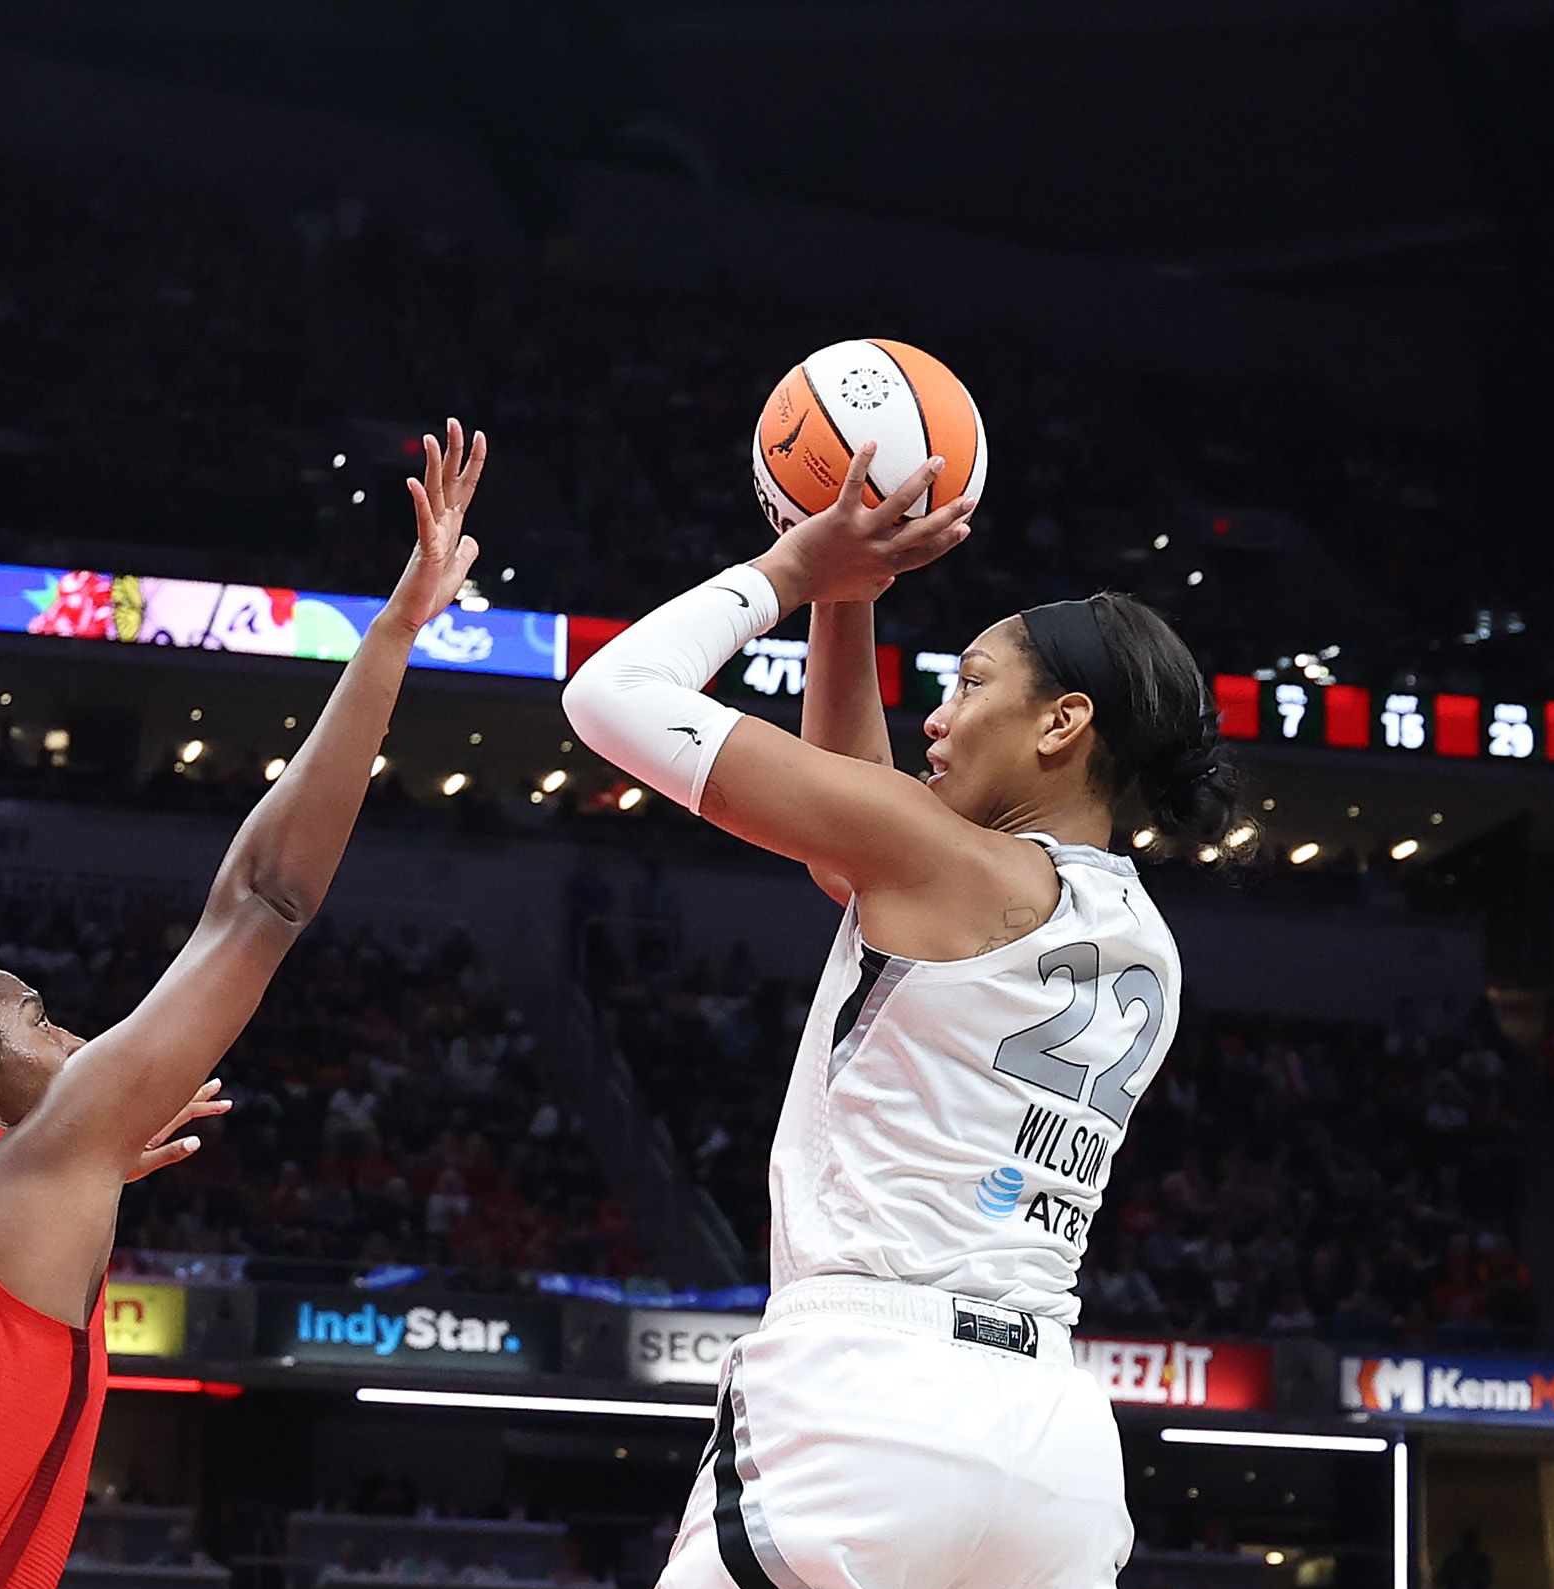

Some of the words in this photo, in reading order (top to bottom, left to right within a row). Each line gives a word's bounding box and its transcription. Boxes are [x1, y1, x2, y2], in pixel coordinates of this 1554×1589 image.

[743, 656, 808, 695] 4/1
[1278, 702, 1306, 738] 7
[993, 941, 1167, 1131] 22
[1013, 1102, 1111, 1190] WILSON
[638, 1330, 742, 1364] SEC
